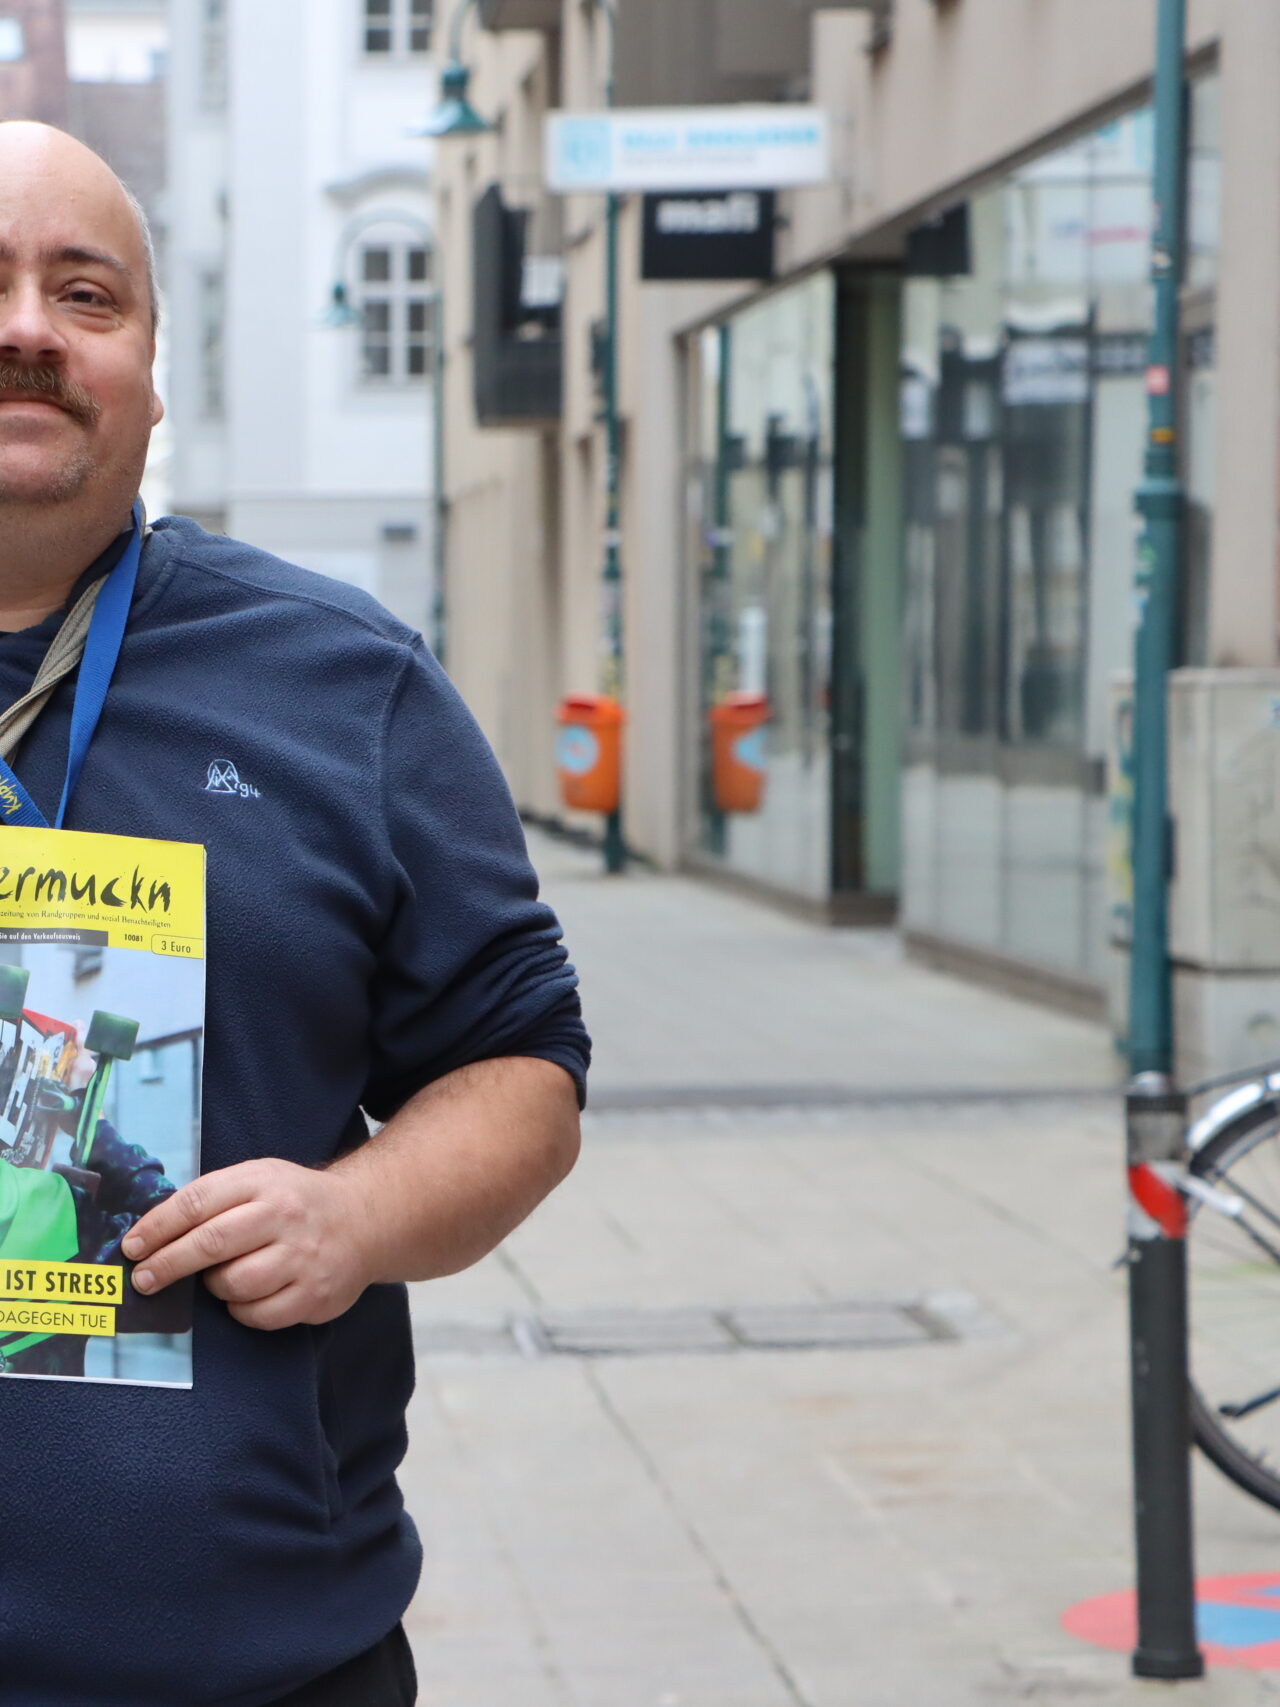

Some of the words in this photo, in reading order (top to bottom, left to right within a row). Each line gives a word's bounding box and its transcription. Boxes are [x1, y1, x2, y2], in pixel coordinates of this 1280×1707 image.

[41, 909, 86, 920] Randgruppen
[87, 912, 100, 920] und
[101, 914, 120, 923] sozial
[121, 915, 172, 929] Benachteiligten
[9, 932, 20, 940] auf
[20, 932, 32, 940] den
[33, 931, 81, 941] Verkaufsausweis
[124, 933, 144, 942] 10081
[161, 940, 167, 951] 3
[170, 941, 191, 953] Euro
[6, 1269, 37, 1292] IST
[45, 1271, 117, 1296] STRESS
[80, 1313, 108, 1329] TUE
